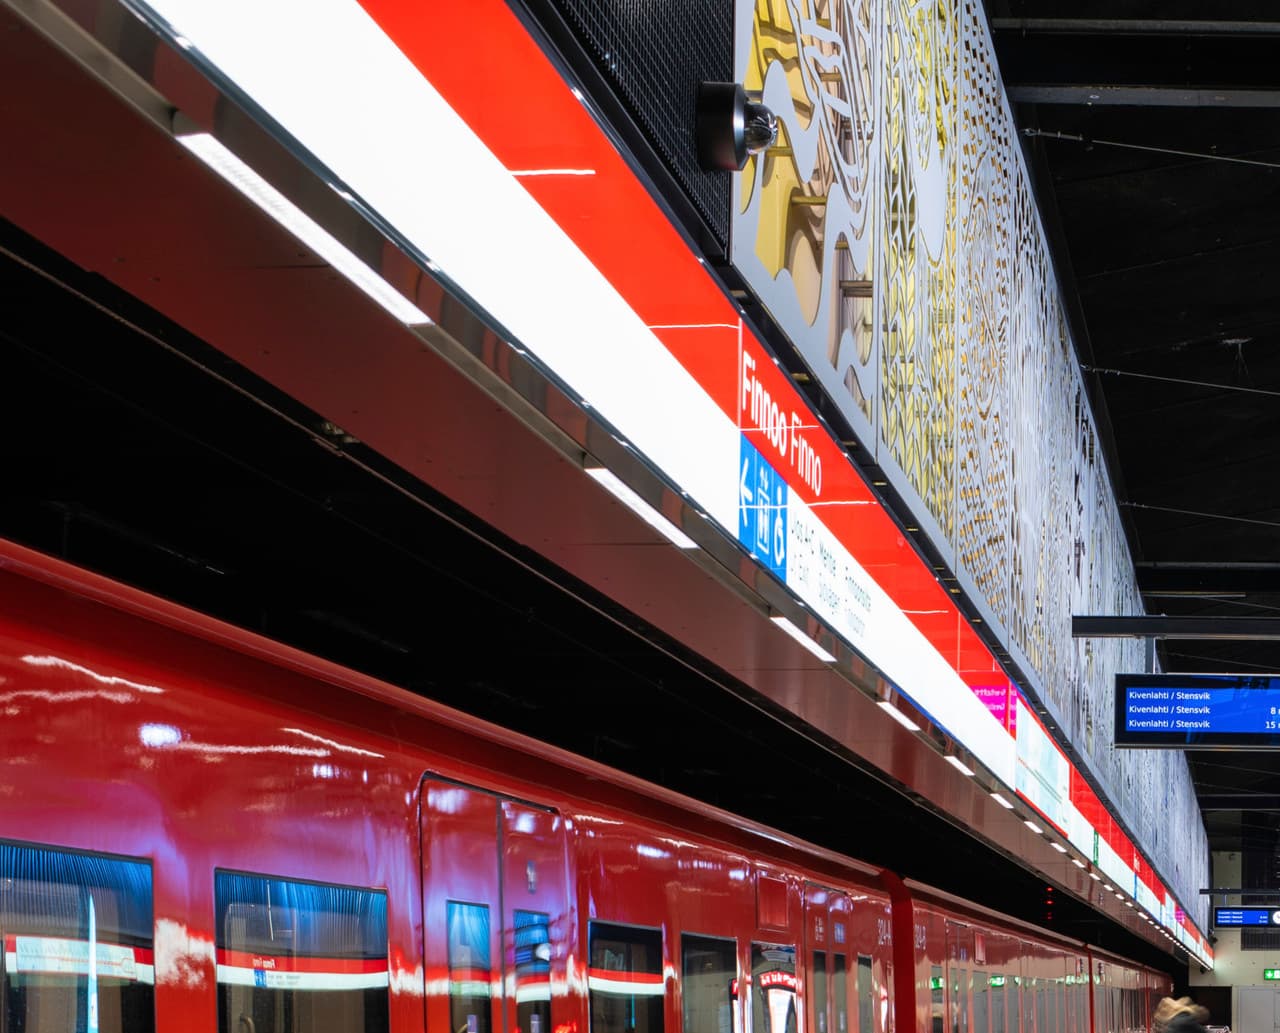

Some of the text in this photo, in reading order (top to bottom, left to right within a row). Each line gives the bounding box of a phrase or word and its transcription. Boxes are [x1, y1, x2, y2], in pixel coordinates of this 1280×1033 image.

[742, 350, 823, 497] Finnoo Finno
[1129, 691, 1169, 699] Kivenlahti
[1176, 692, 1211, 700] Stensvik
[1129, 705, 1169, 713] Kivenlahti
[1176, 706, 1211, 714] Stensvik
[1270, 707, 1276, 715] 8
[1129, 719, 1169, 727] Kivenlahti
[1176, 720, 1211, 728] Stensvik
[1265, 721, 1276, 729] 15
